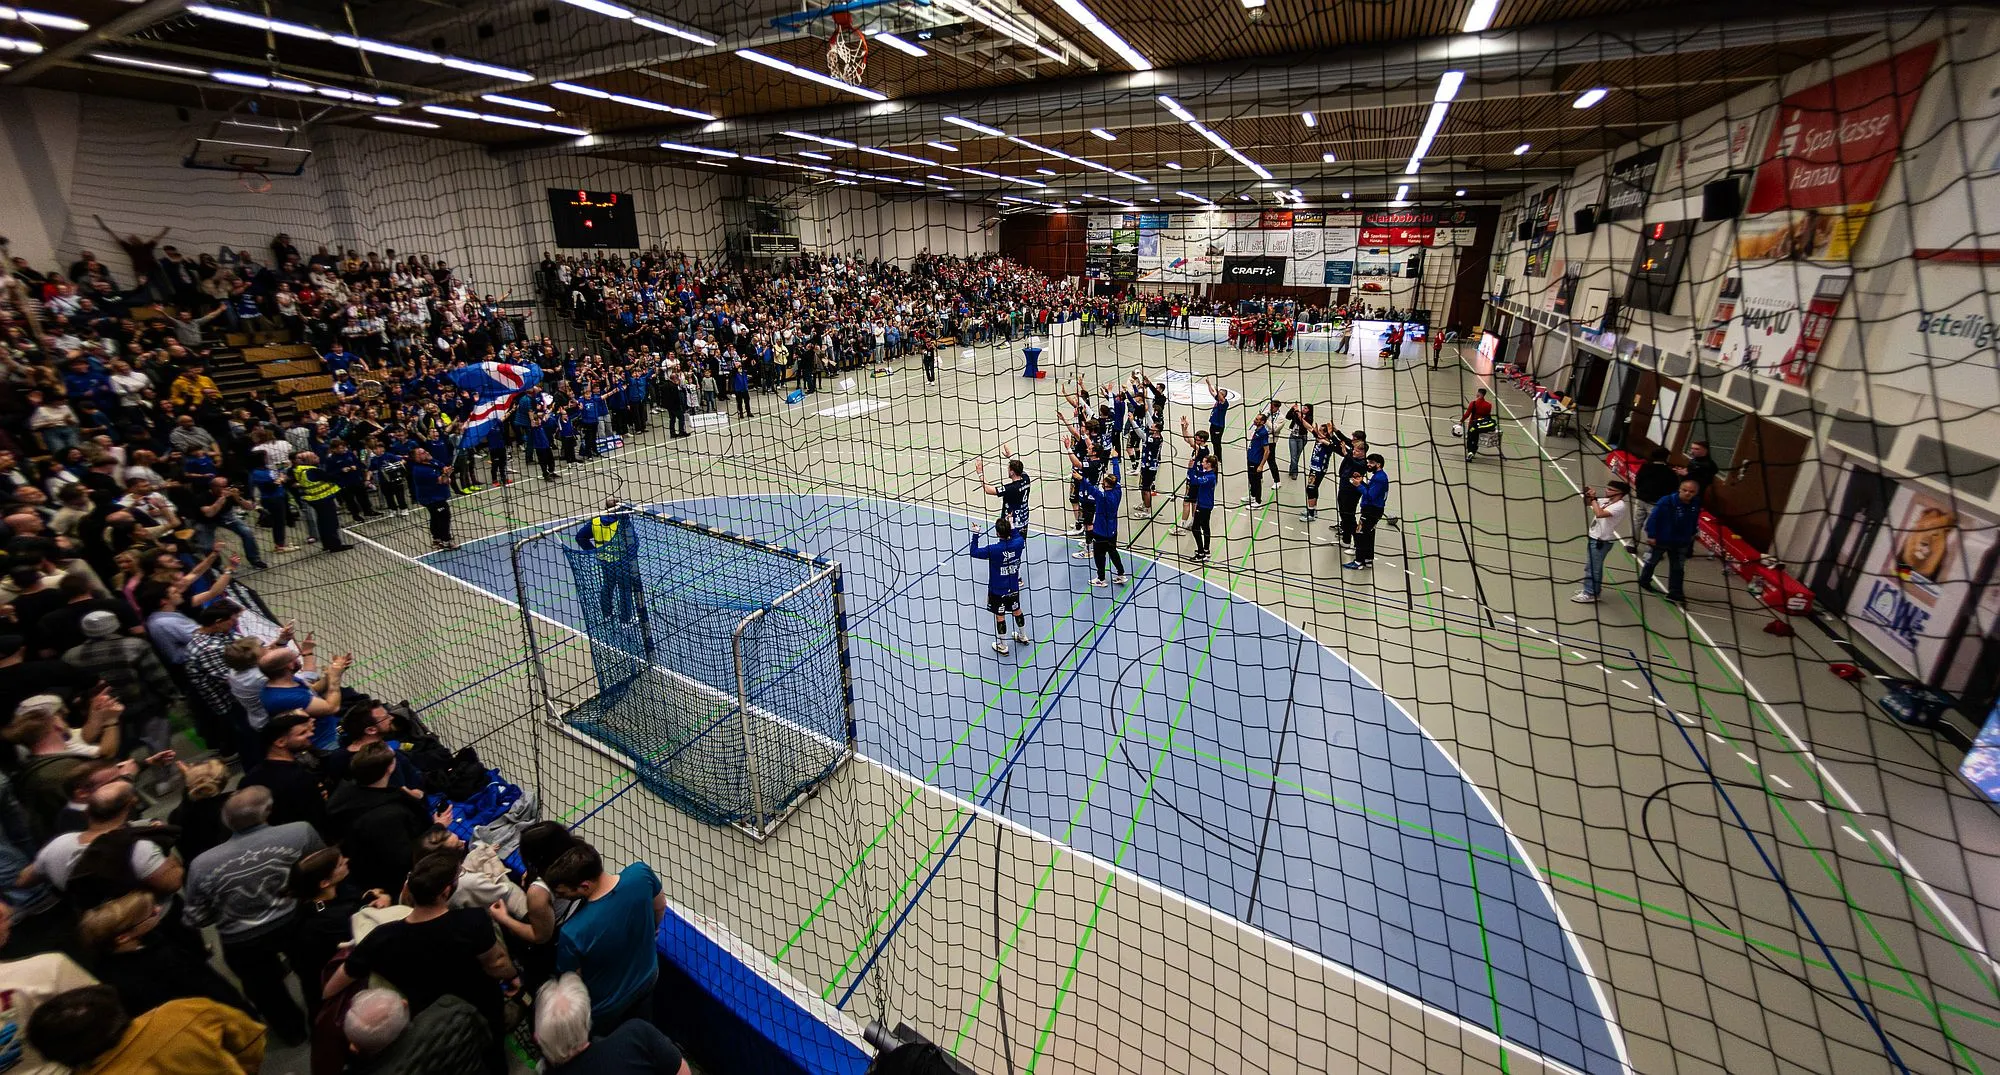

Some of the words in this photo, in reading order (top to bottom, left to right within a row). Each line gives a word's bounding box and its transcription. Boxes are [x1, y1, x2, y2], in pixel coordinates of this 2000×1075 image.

[1801, 113, 1892, 158] Sparkasse
[1789, 165, 1841, 190] Hanau
[1231, 267, 1266, 275] CRAFT
